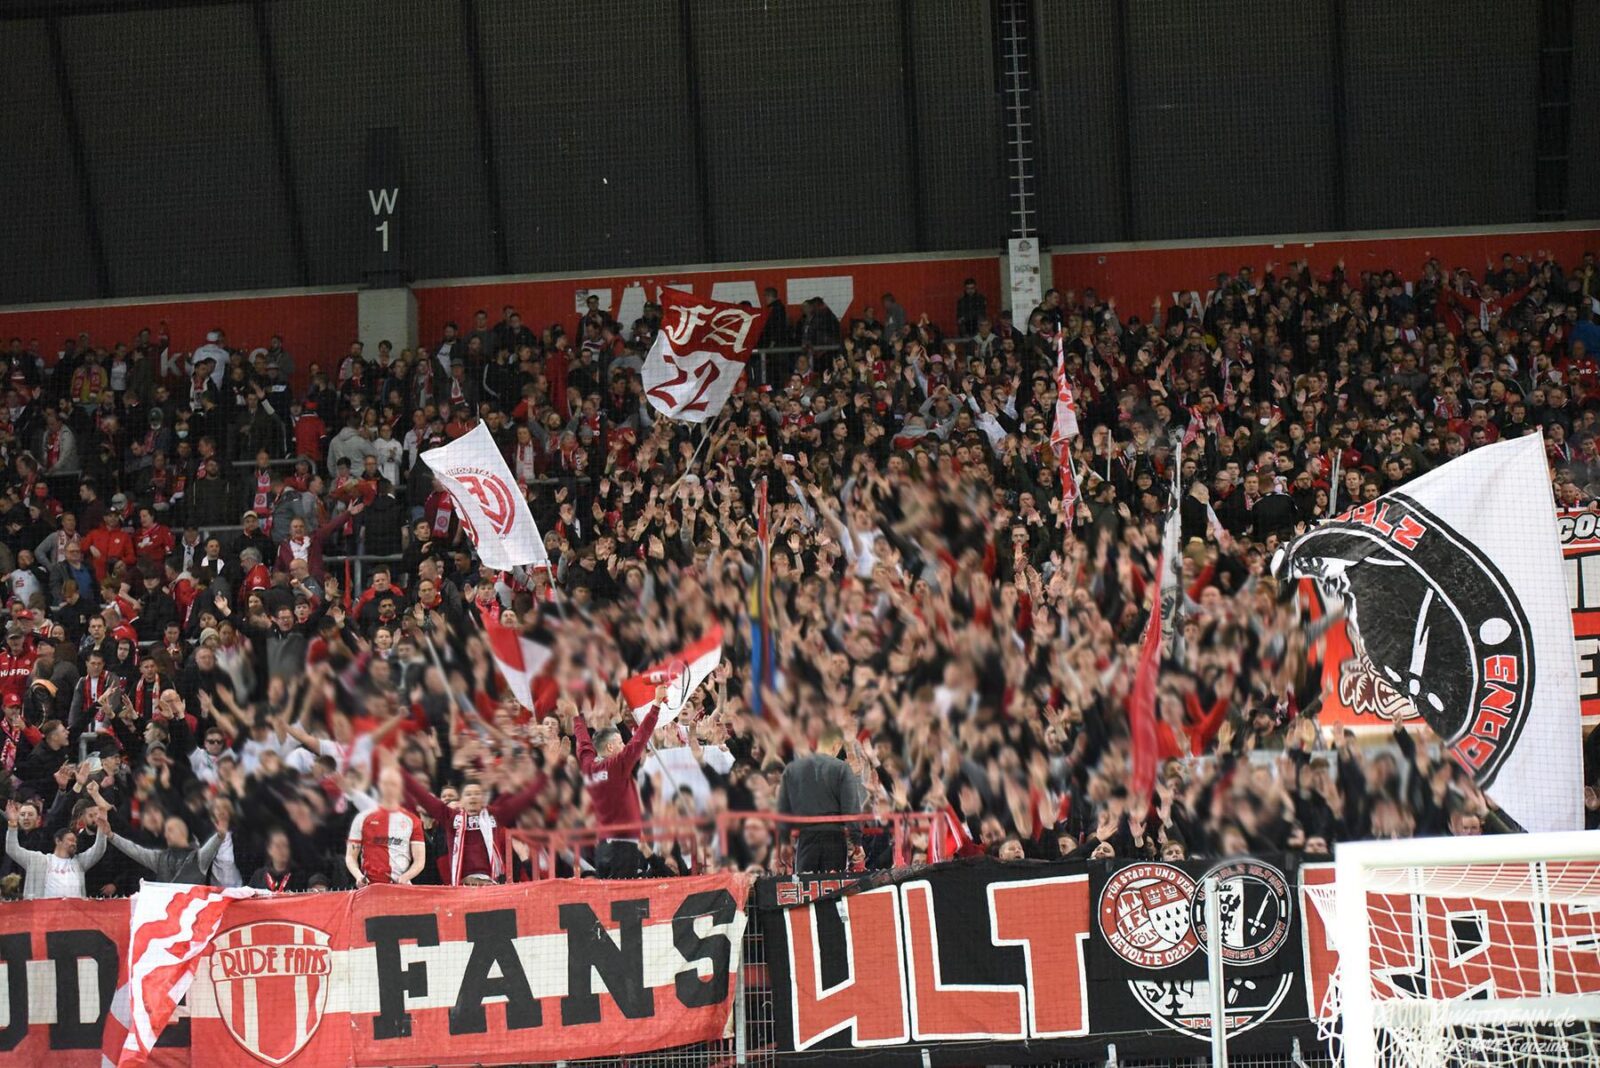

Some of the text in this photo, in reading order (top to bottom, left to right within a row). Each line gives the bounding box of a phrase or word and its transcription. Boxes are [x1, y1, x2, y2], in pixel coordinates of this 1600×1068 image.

[368, 187, 399, 215] W
[375, 221, 388, 252] 1
[646, 354, 720, 412] 22
[1107, 884, 1122, 900] FÜR
[1120, 867, 1151, 884] STADT
[1155, 867, 1176, 880] UND
[219, 947, 278, 978] RUDE
[365, 888, 737, 1040] FANS
[1109, 931, 1194, 965] REVOLTE 0221
